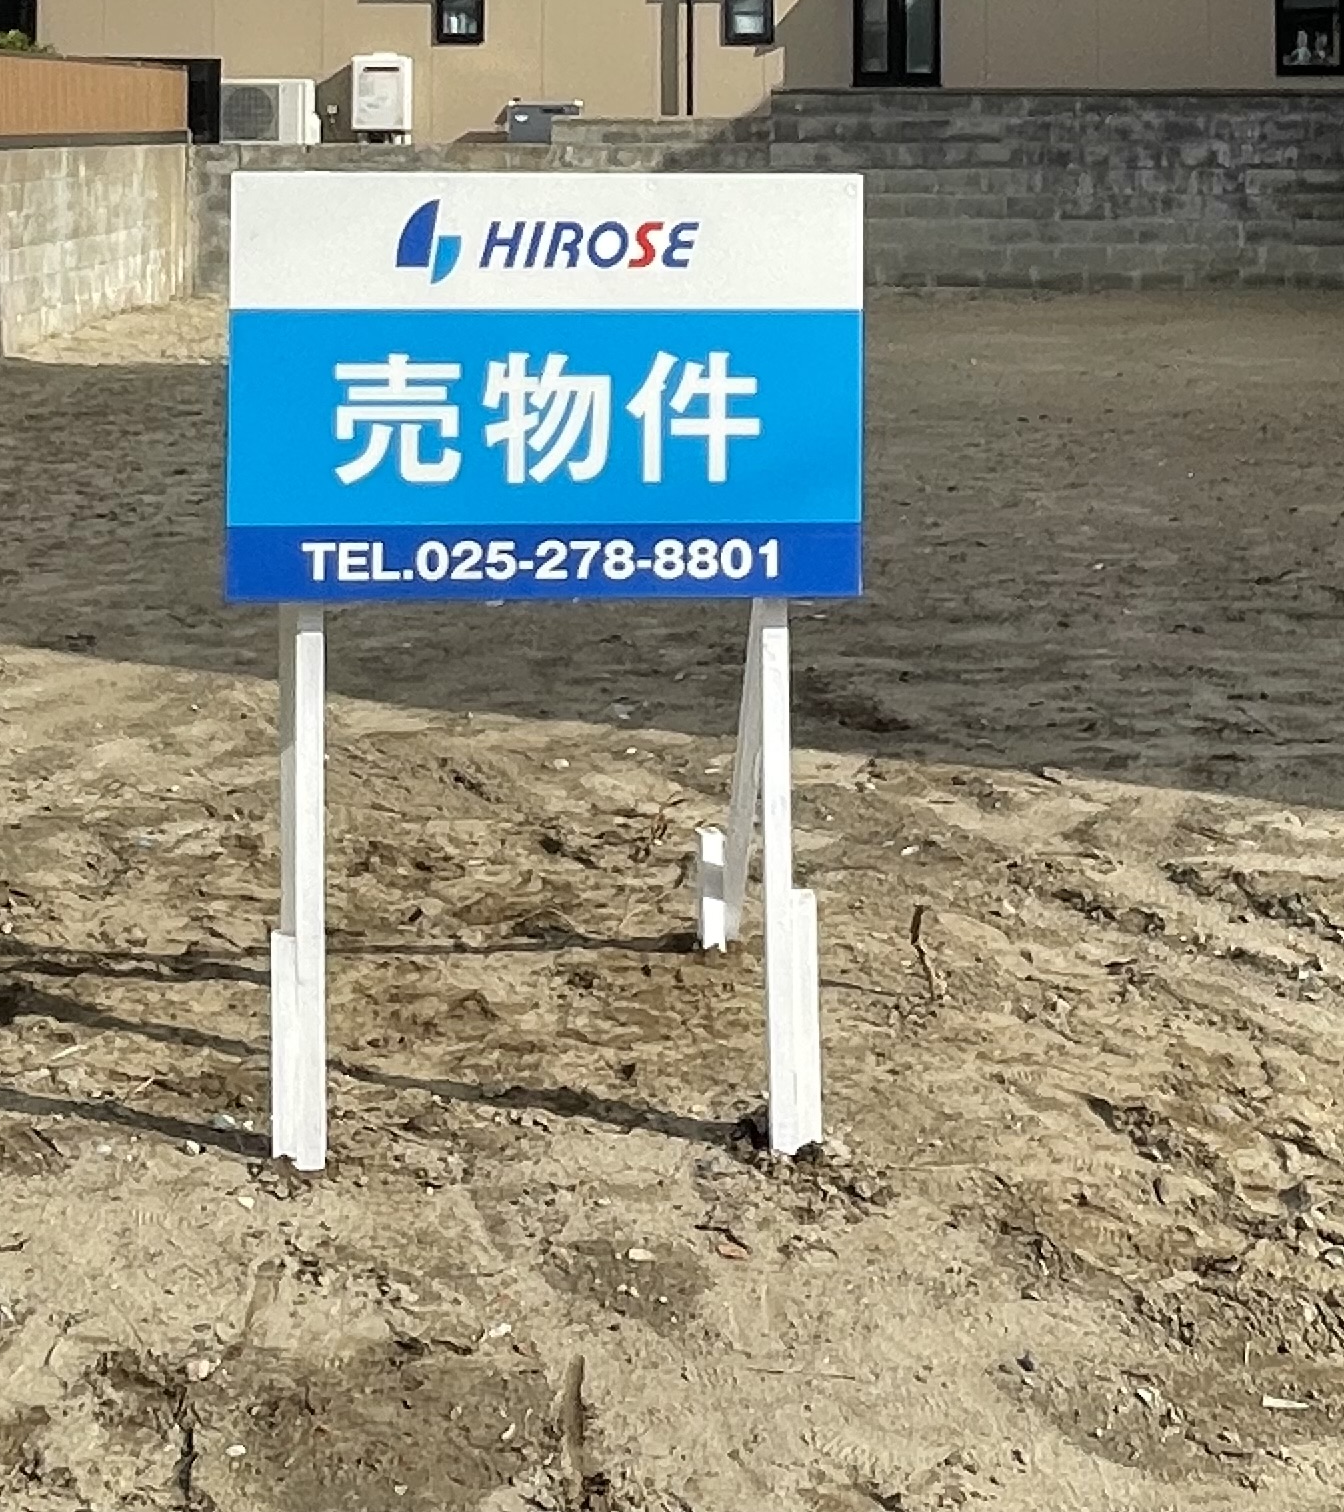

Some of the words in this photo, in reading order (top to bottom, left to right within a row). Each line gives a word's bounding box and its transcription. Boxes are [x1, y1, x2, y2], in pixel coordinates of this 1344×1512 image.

[479, 220, 700, 268] HIROSE
[334, 350, 760, 484] 売物件
[301, 538, 778, 582] TEL.025-278-8801
